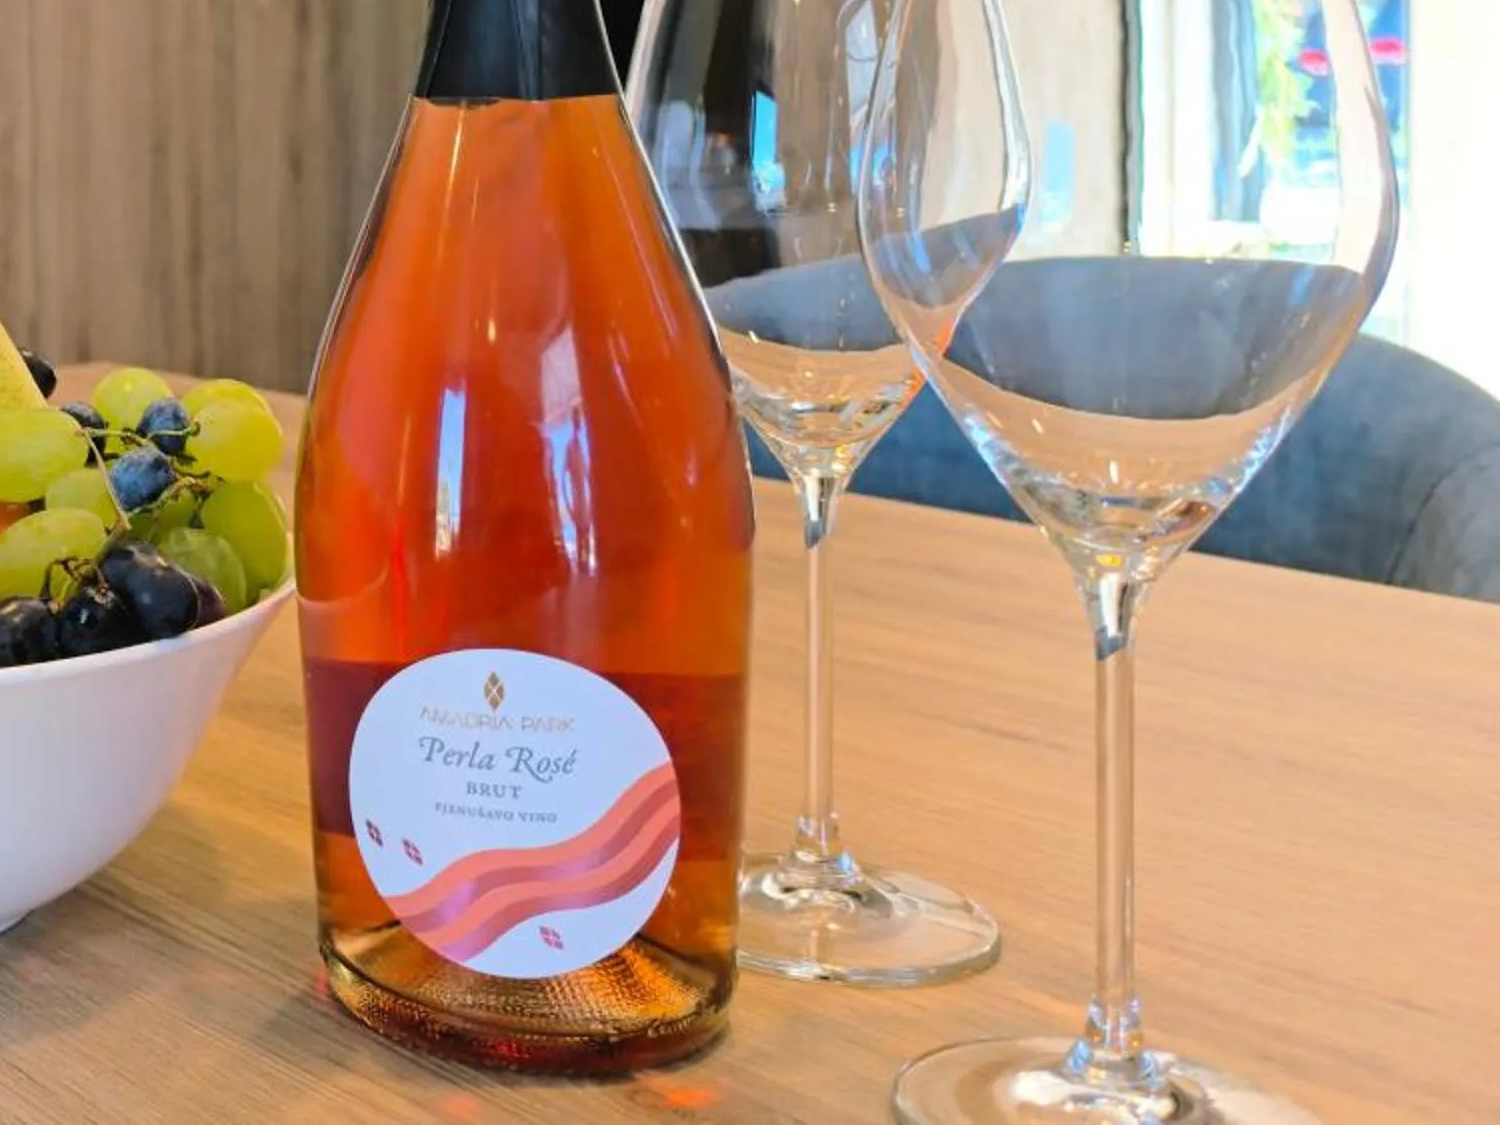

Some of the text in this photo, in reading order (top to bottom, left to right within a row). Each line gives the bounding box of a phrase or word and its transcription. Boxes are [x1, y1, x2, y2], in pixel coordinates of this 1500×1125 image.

[520, 716, 576, 732] PARK
[419, 736, 577, 784] Perla Rosé
[466, 781, 523, 800] BRUT
[518, 811, 558, 823] VINO
